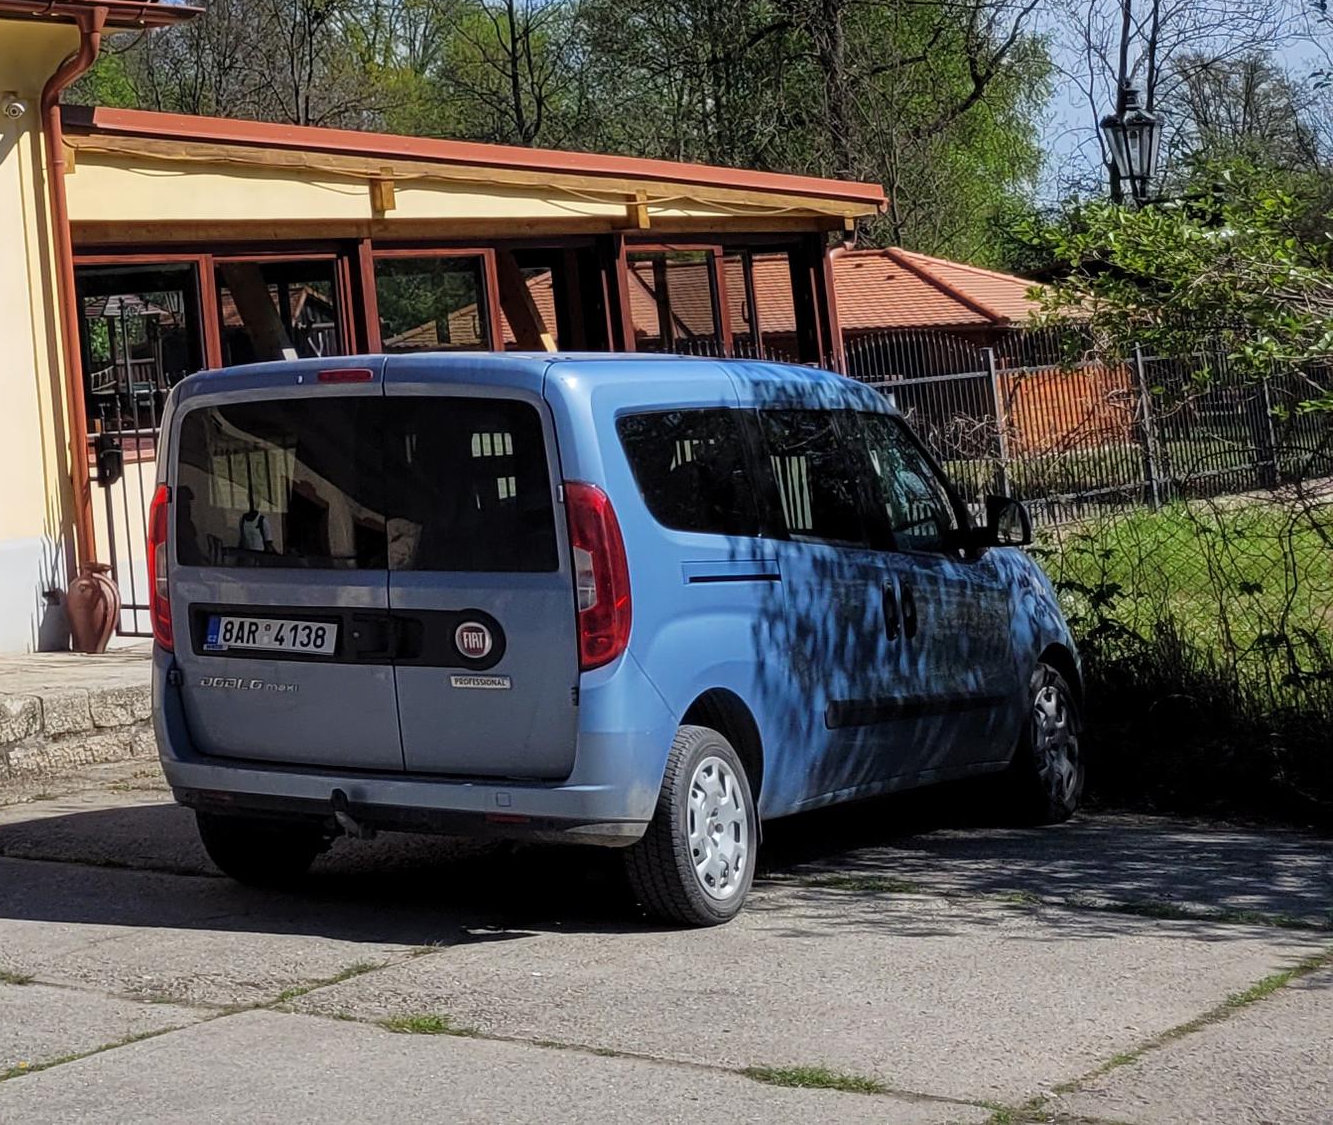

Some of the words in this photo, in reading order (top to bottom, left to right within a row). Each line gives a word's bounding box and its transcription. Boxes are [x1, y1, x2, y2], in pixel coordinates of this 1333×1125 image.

[222, 621, 259, 644] 8AR
[274, 623, 326, 648] 4138
[462, 631, 484, 649] FIAT
[453, 678, 507, 686] PROFESSIONAL
